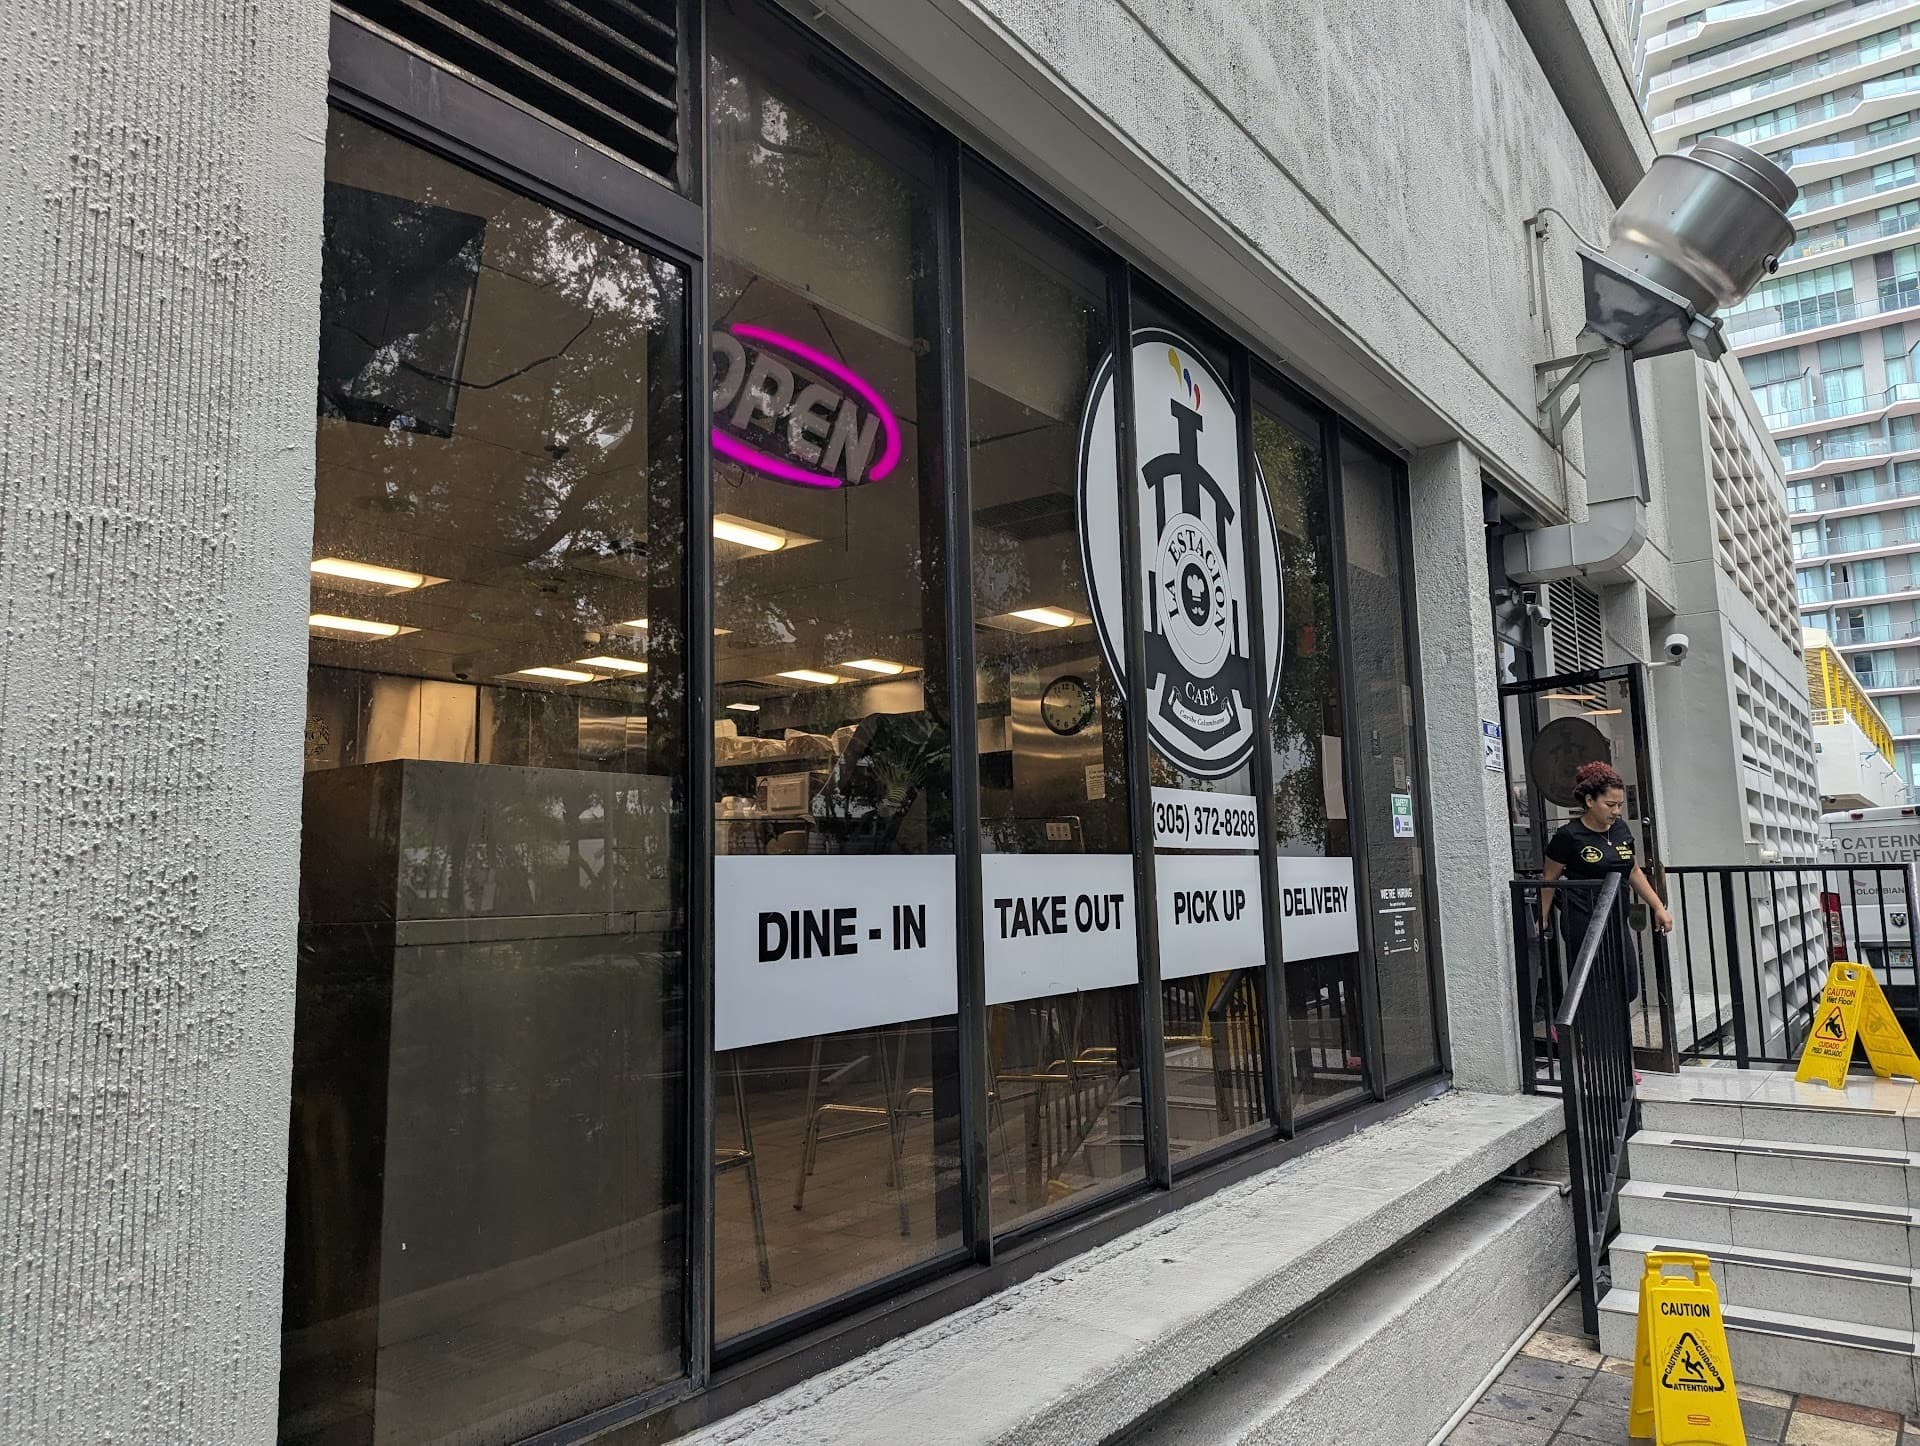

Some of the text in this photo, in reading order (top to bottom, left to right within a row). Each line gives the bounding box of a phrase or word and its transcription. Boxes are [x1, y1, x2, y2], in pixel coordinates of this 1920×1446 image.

[712, 331, 880, 485] OPEN
[1165, 529, 1226, 636] LA ESTACION
[1153, 802, 1256, 842] (305) 372-8288
[1173, 889, 1246, 926] PICK UP
[1283, 885, 1349, 917] DELIVERY
[1855, 887, 1904, 896] OLOBIAN
[994, 894, 1125, 939] TAKE OUT
[759, 908, 858, 963] DINE
[892, 905, 927, 950] IN
[1827, 987, 1856, 998] CAUTION
[1827, 996, 1837, 1004] Wet
[1838, 996, 1853, 1006] Floor
[1660, 1302, 1711, 1318] CAUTION
[1665, 1343, 1683, 1375] CAUTION
[1695, 1344, 1719, 1377] CUIDADO
[1673, 1384, 1714, 1393] ATTENTION
